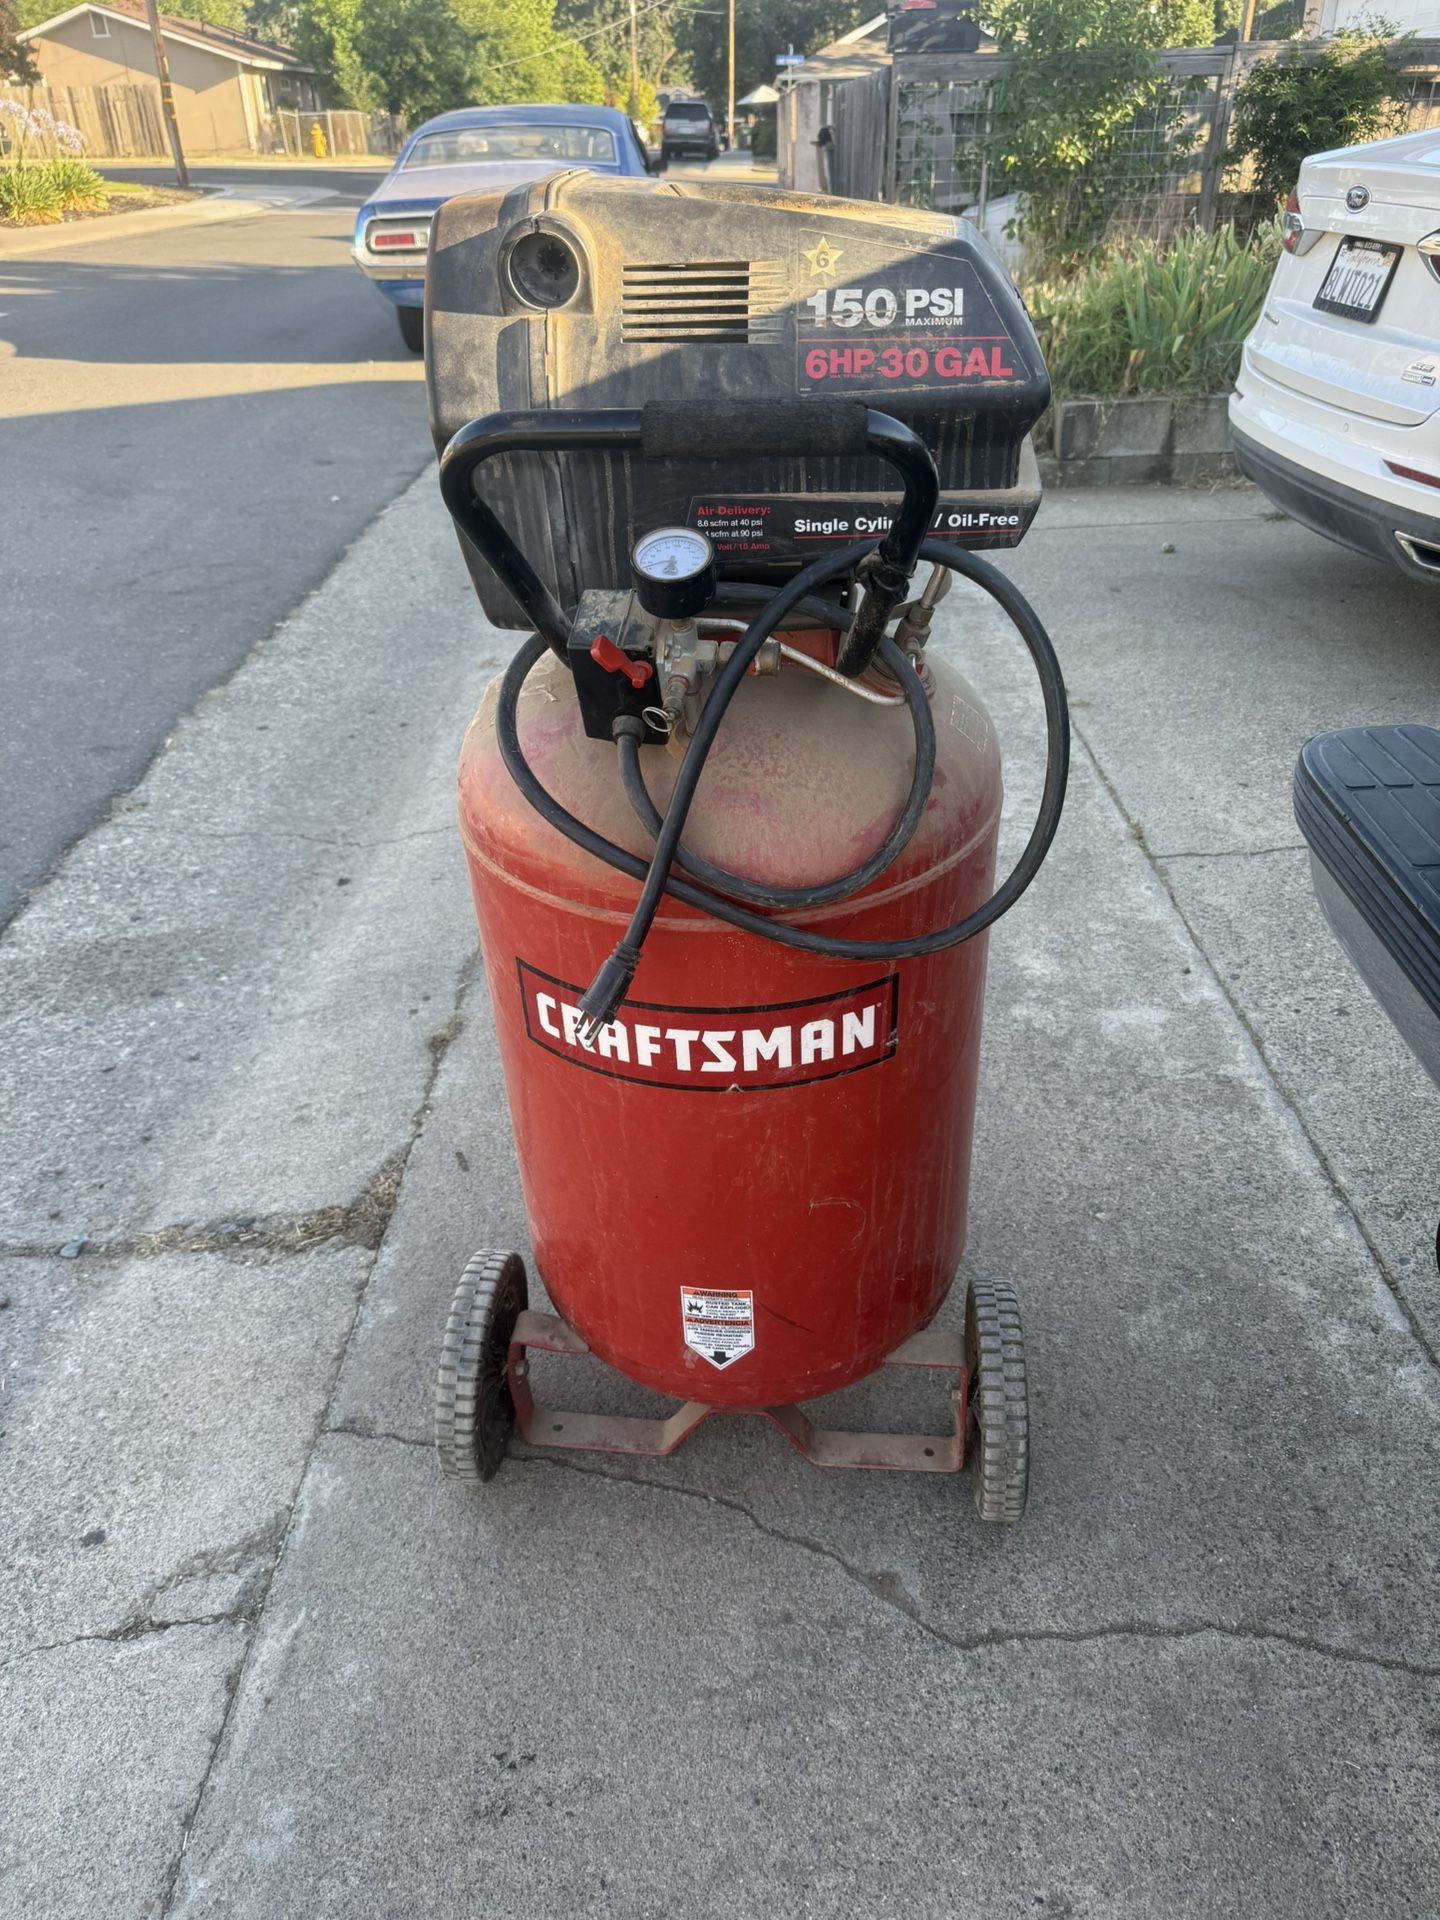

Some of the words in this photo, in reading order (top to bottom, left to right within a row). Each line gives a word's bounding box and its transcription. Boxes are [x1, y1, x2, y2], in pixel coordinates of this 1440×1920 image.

[815, 251, 828, 268] 6
[806, 288, 898, 328] 150
[906, 288, 963, 317] PSI
[905, 317, 963, 326] MAXIMUM
[805, 348, 875, 379] 6HP
[880, 348, 929, 378] 30
[935, 347, 1013, 378] GAL
[698, 506, 714, 515] Air
[718, 506, 771, 517] Delivery:
[751, 518, 763, 527] psi
[794, 518, 849, 534] Single
[934, 513, 942, 527] /
[948, 513, 1018, 527] Oil-Free
[752, 529, 763, 537] psi
[751, 543, 769, 551] Amp
[536, 991, 876, 1073] CRAFTSMAN
